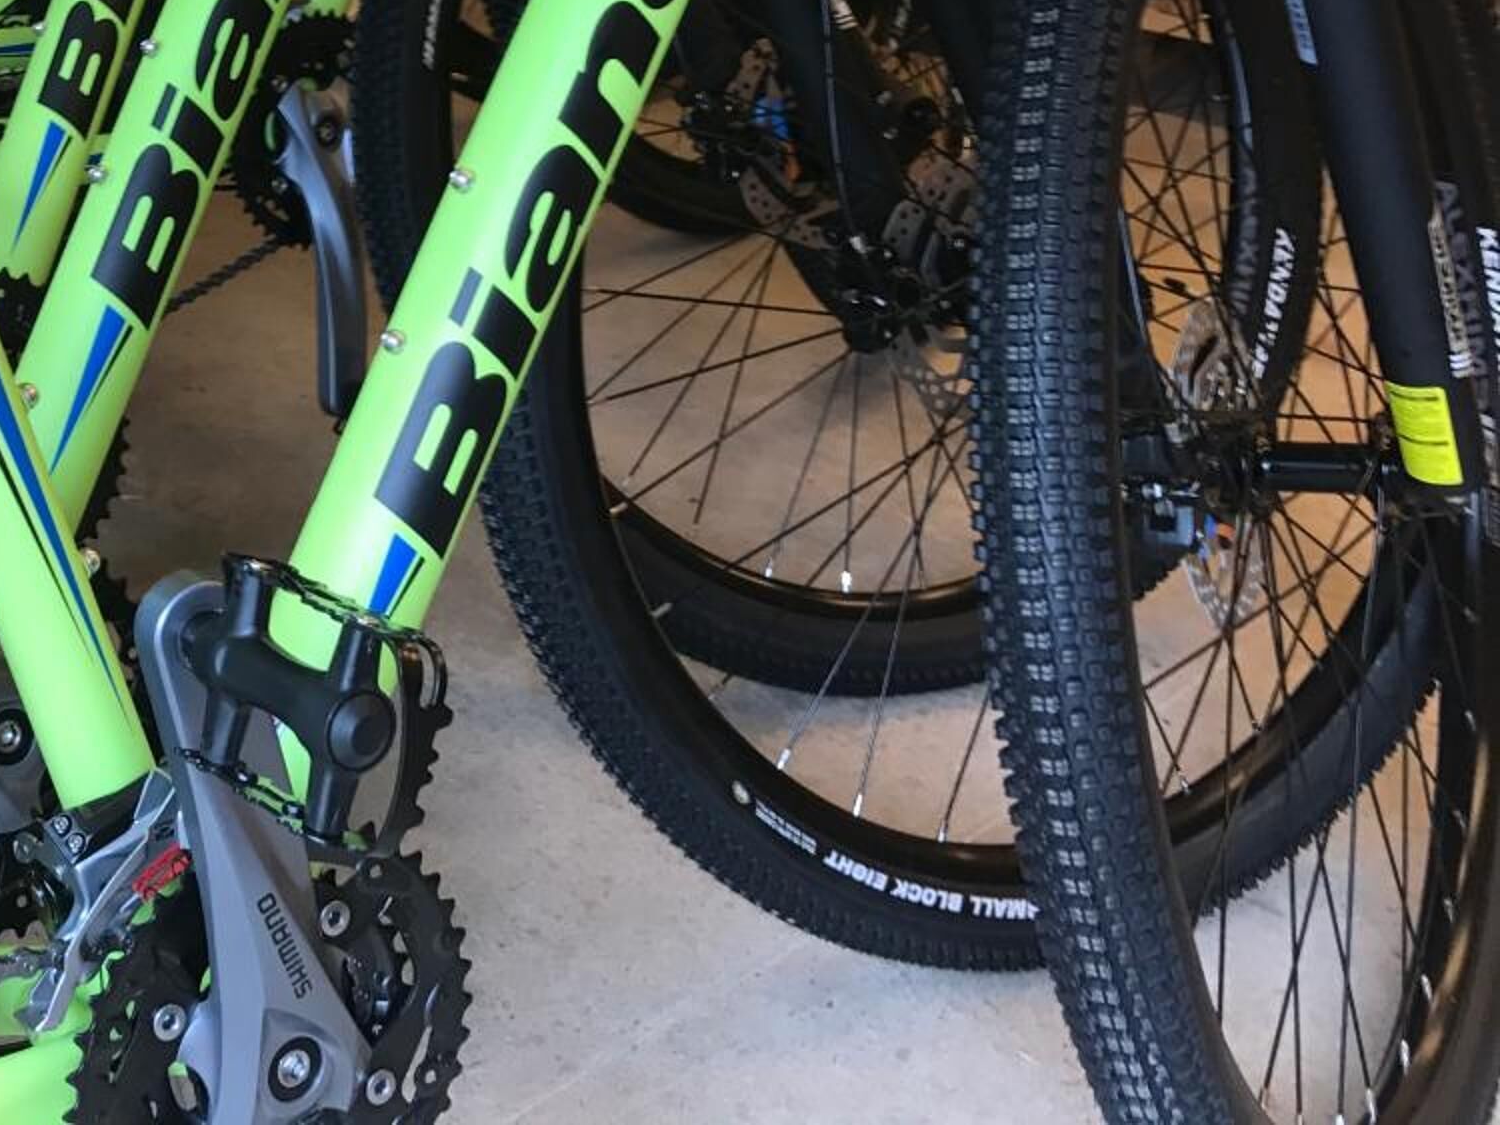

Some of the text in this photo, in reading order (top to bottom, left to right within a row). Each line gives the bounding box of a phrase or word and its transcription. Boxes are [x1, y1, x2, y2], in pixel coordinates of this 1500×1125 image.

[822, 849, 890, 892] EIGHT
[890, 877, 964, 913] BLOCK
[257, 891, 313, 1000] SHIMANO
